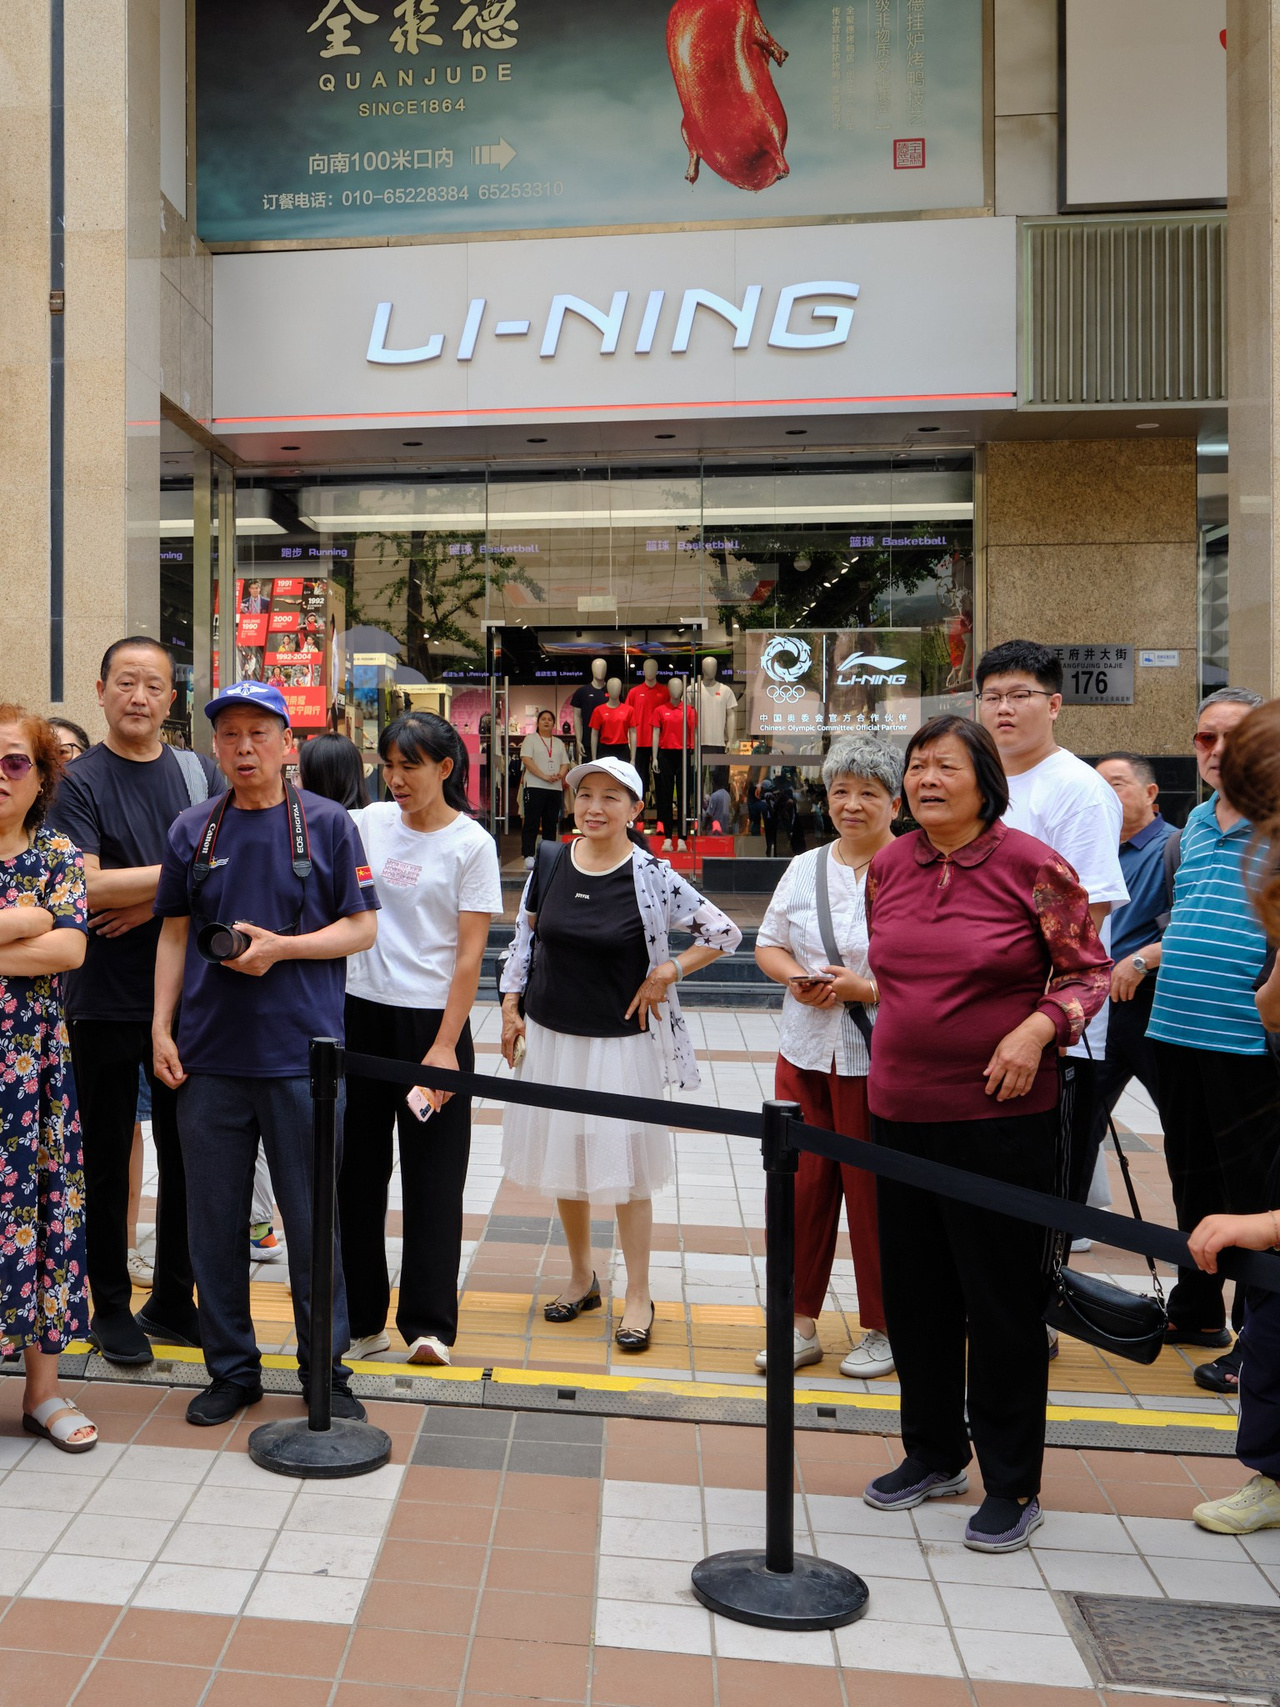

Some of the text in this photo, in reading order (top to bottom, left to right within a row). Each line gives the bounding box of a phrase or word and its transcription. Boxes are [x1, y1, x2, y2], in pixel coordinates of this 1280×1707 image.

[319, 63, 512, 92] QUANJUDE
[358, 98, 466, 117] SINCE1864
[308, 147, 454, 175] 向南100米口内
[342, 185, 469, 206] 010-65228384
[478, 181, 564, 199] 65253310
[366, 280, 860, 364] LI-NING
[480, 544, 540, 553] Basketball
[677, 540, 739, 550] Basketball
[849, 536, 947, 547] 篮球 Basketball
[160, 551, 183, 560] nning
[281, 547, 348, 558] 跑步 Running
[1054, 648, 1127, 660] 王府井大街
[837, 674, 907, 685] LI-NING
[1071, 671, 1108, 694] 176
[788, 724, 815, 732] Olympic
[292, 803, 304, 854] EOS DIGITAL
[202, 823, 217, 854] Canon
